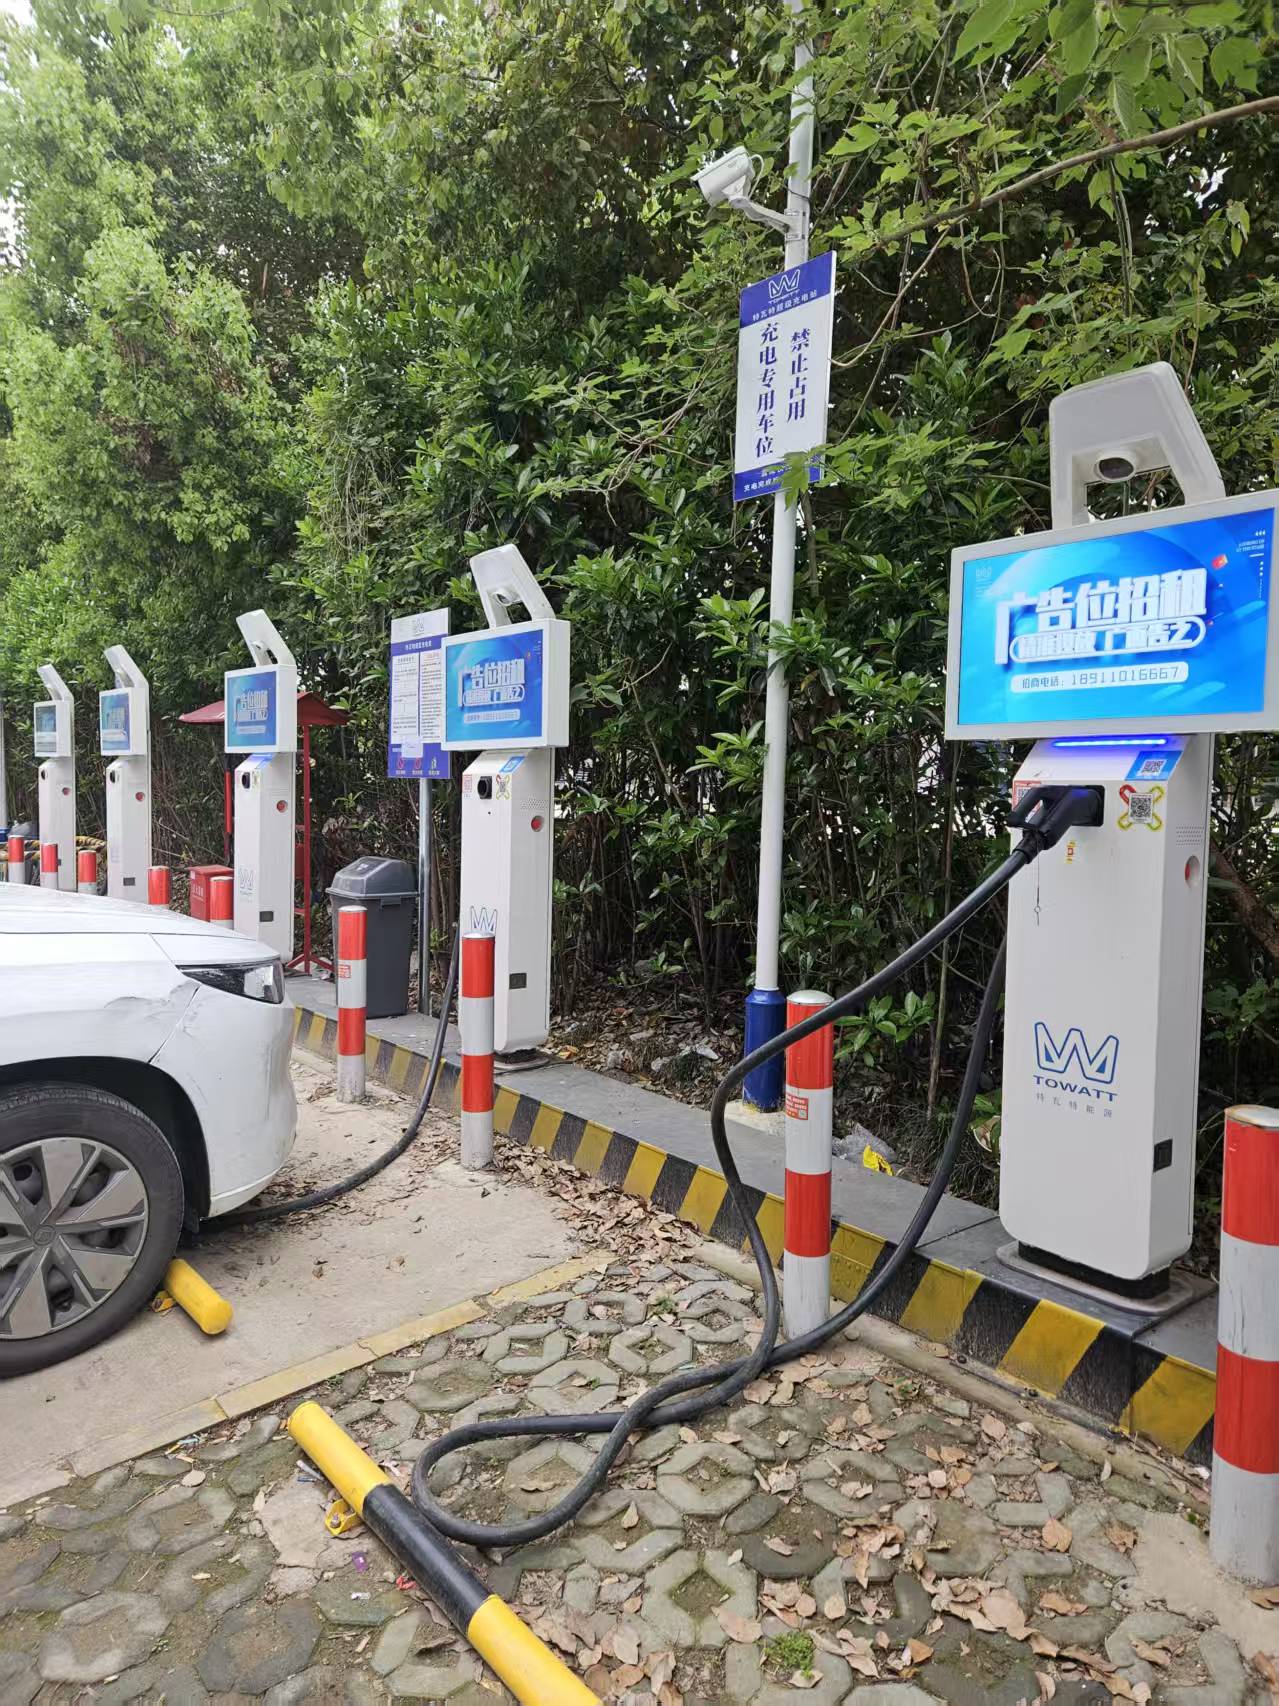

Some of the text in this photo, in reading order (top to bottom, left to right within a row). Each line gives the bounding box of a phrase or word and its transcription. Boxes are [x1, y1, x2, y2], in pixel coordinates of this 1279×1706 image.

[756, 322, 779, 458] 充电专用车位
[786, 327, 811, 424] 禁止占用
[995, 567, 1208, 665] 广告位招租
[1033, 1074, 1118, 1102] TOWATT
